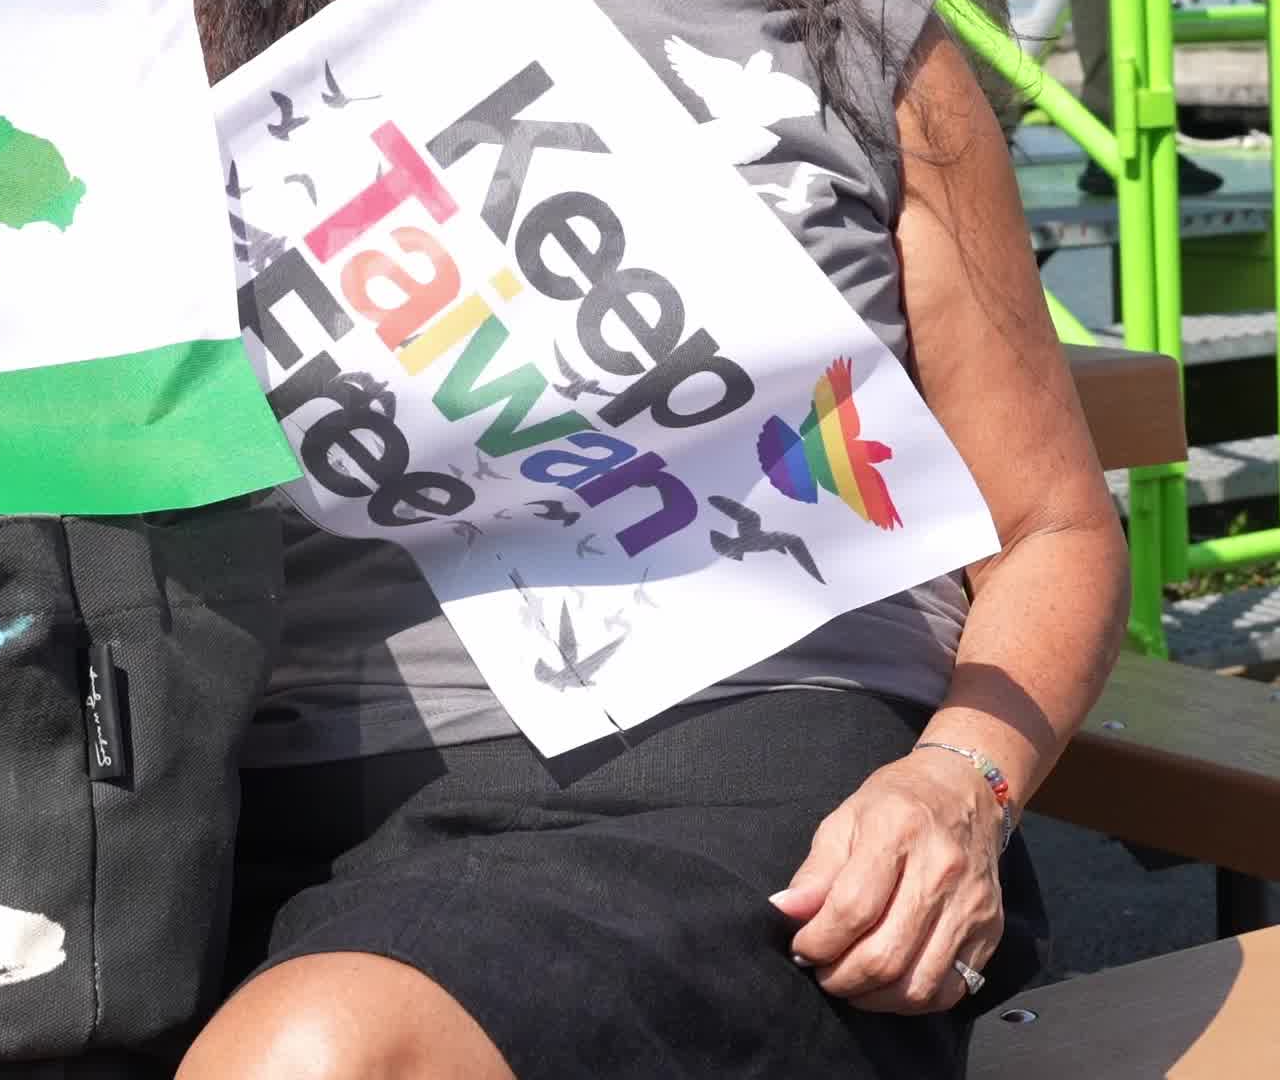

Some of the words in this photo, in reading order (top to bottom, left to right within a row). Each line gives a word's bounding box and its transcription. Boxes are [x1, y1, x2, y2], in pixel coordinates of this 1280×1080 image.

[236, 246, 476, 528] Free
[302, 118, 699, 558] Taiwan
[425, 59, 756, 429] Keep
